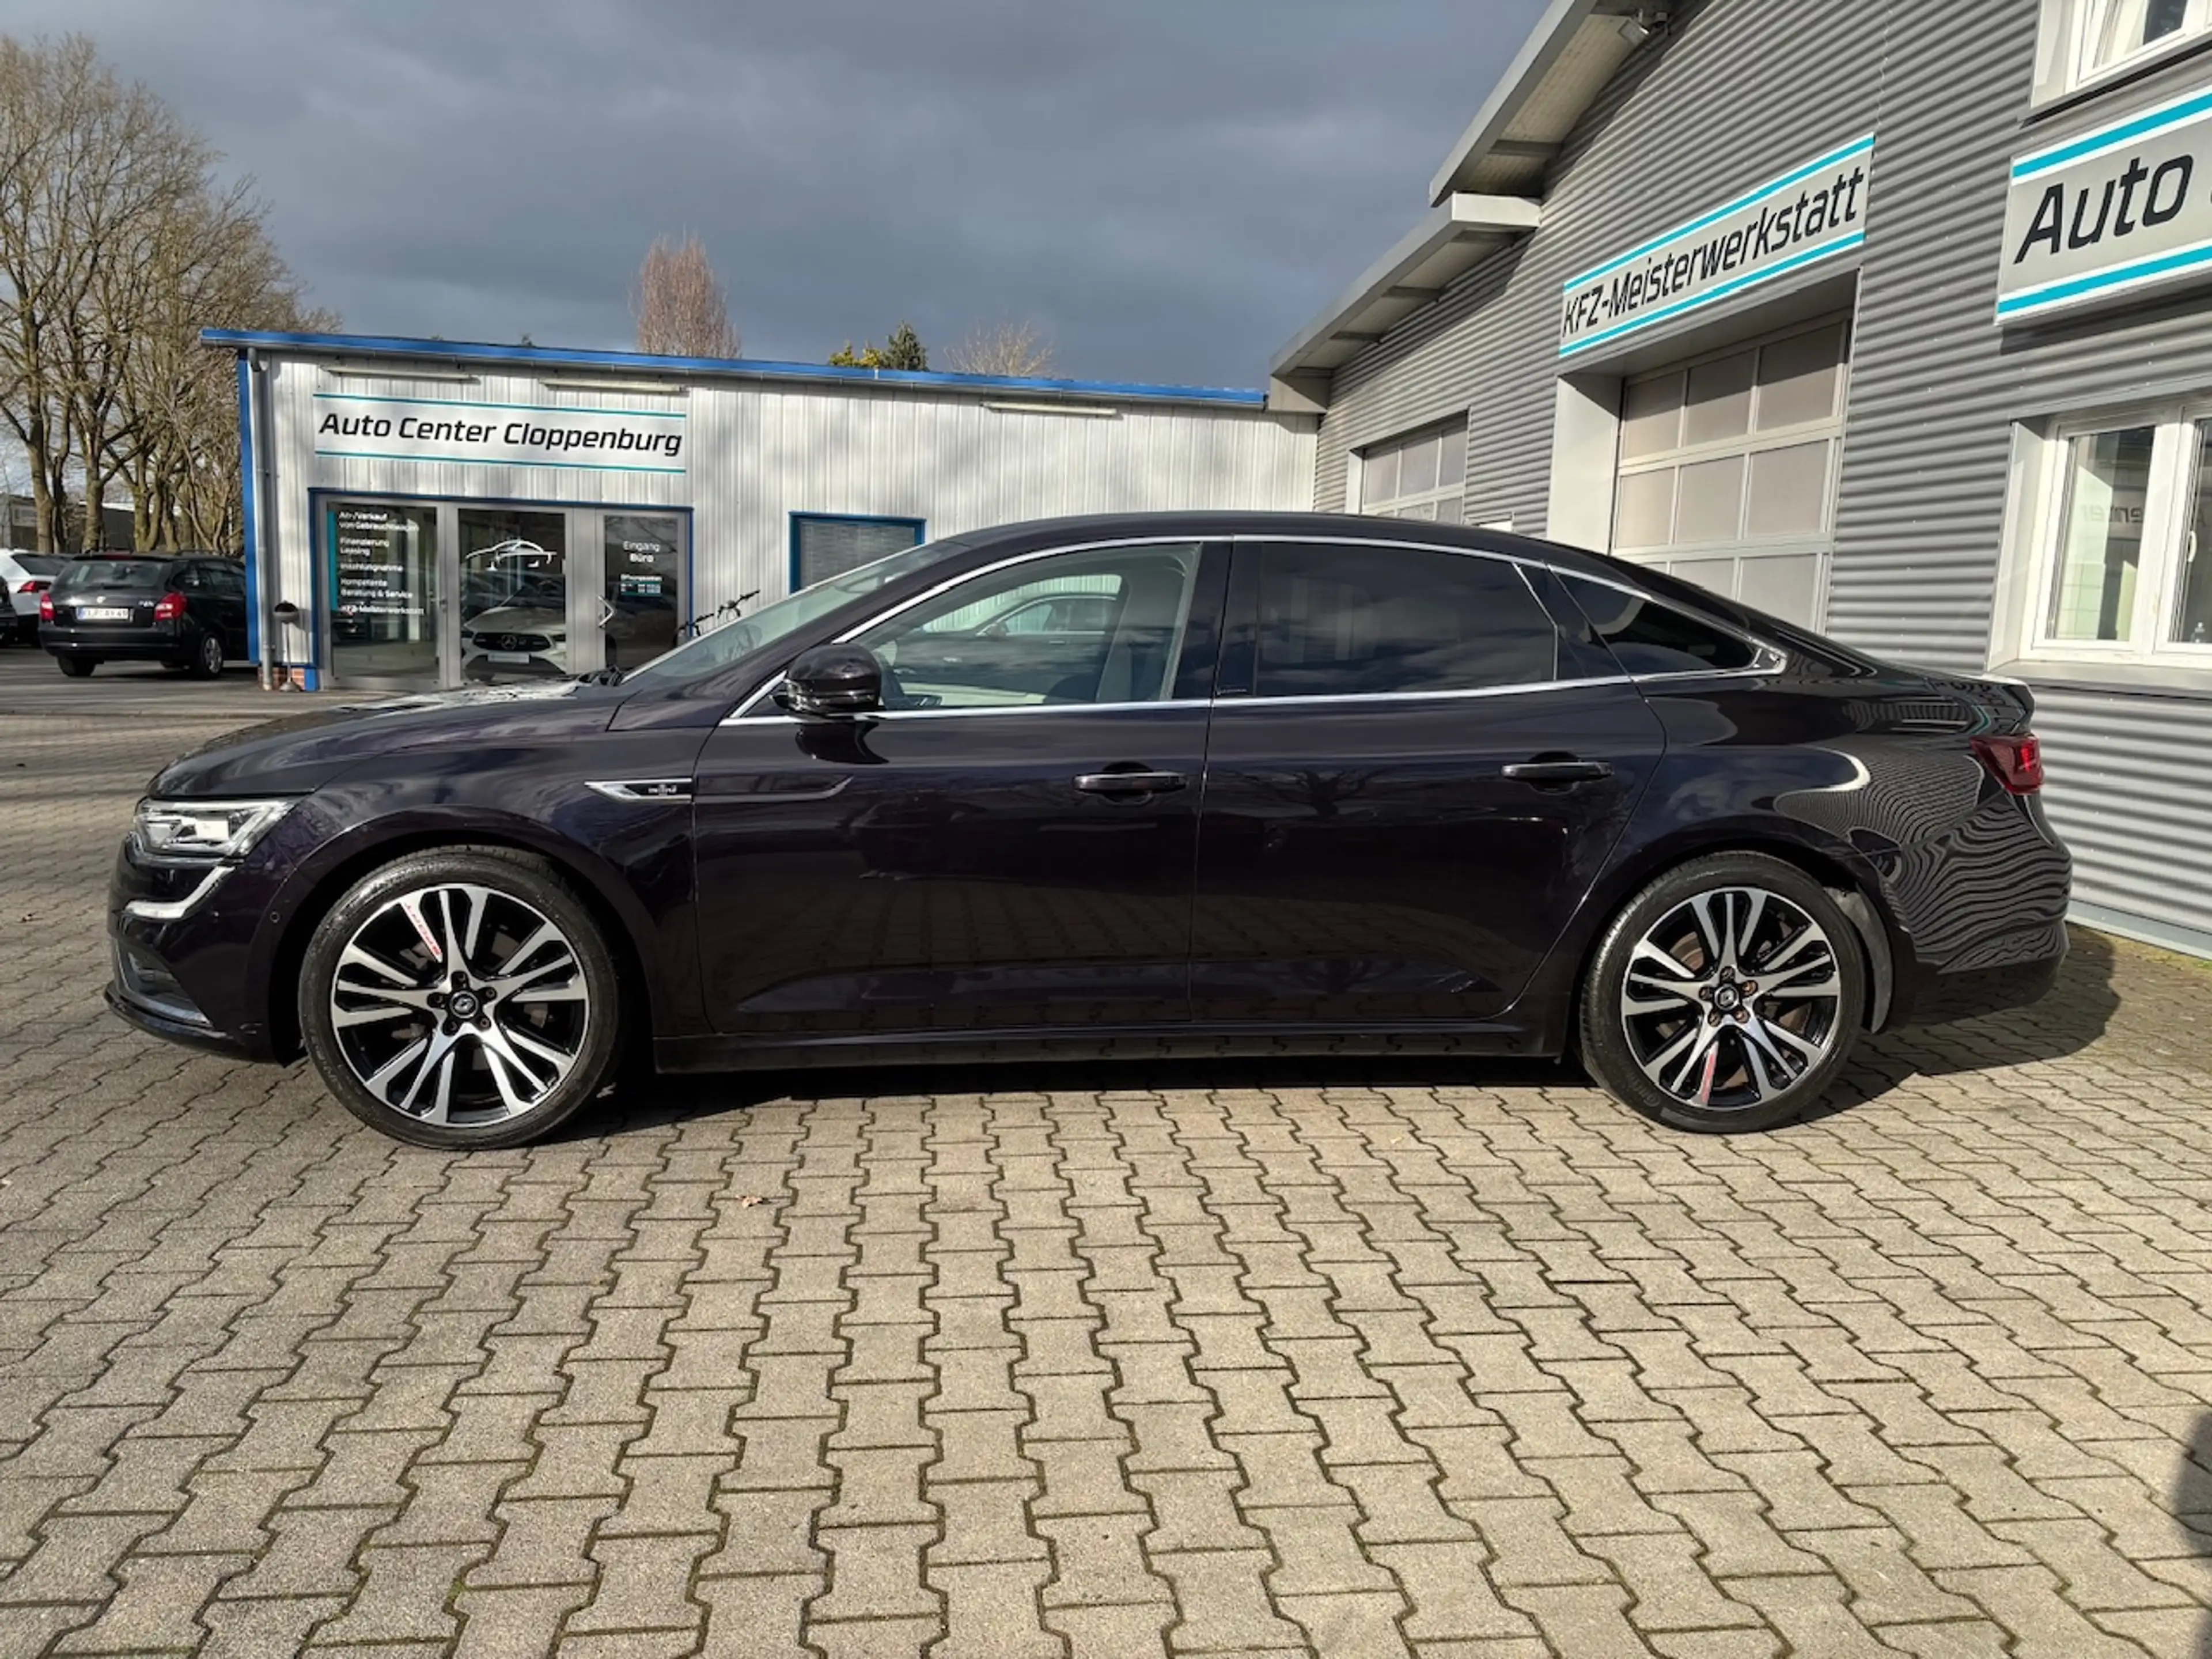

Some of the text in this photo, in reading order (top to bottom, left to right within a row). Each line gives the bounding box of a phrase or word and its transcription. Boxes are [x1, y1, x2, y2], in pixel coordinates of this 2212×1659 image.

[2013, 154, 2194, 264] Auto
[1562, 166, 1865, 338] KFZ-Meisterwerkstatt
[319, 412, 683, 457] Auto Center Cloppenburg
[339, 537, 390, 547] Finanzierung
[623, 540, 660, 552] Eingang
[340, 547, 370, 556] Leasing
[630, 552, 654, 563] Büro
[340, 578, 388, 587] Kompetente
[340, 588, 414, 599] Beratung & Service
